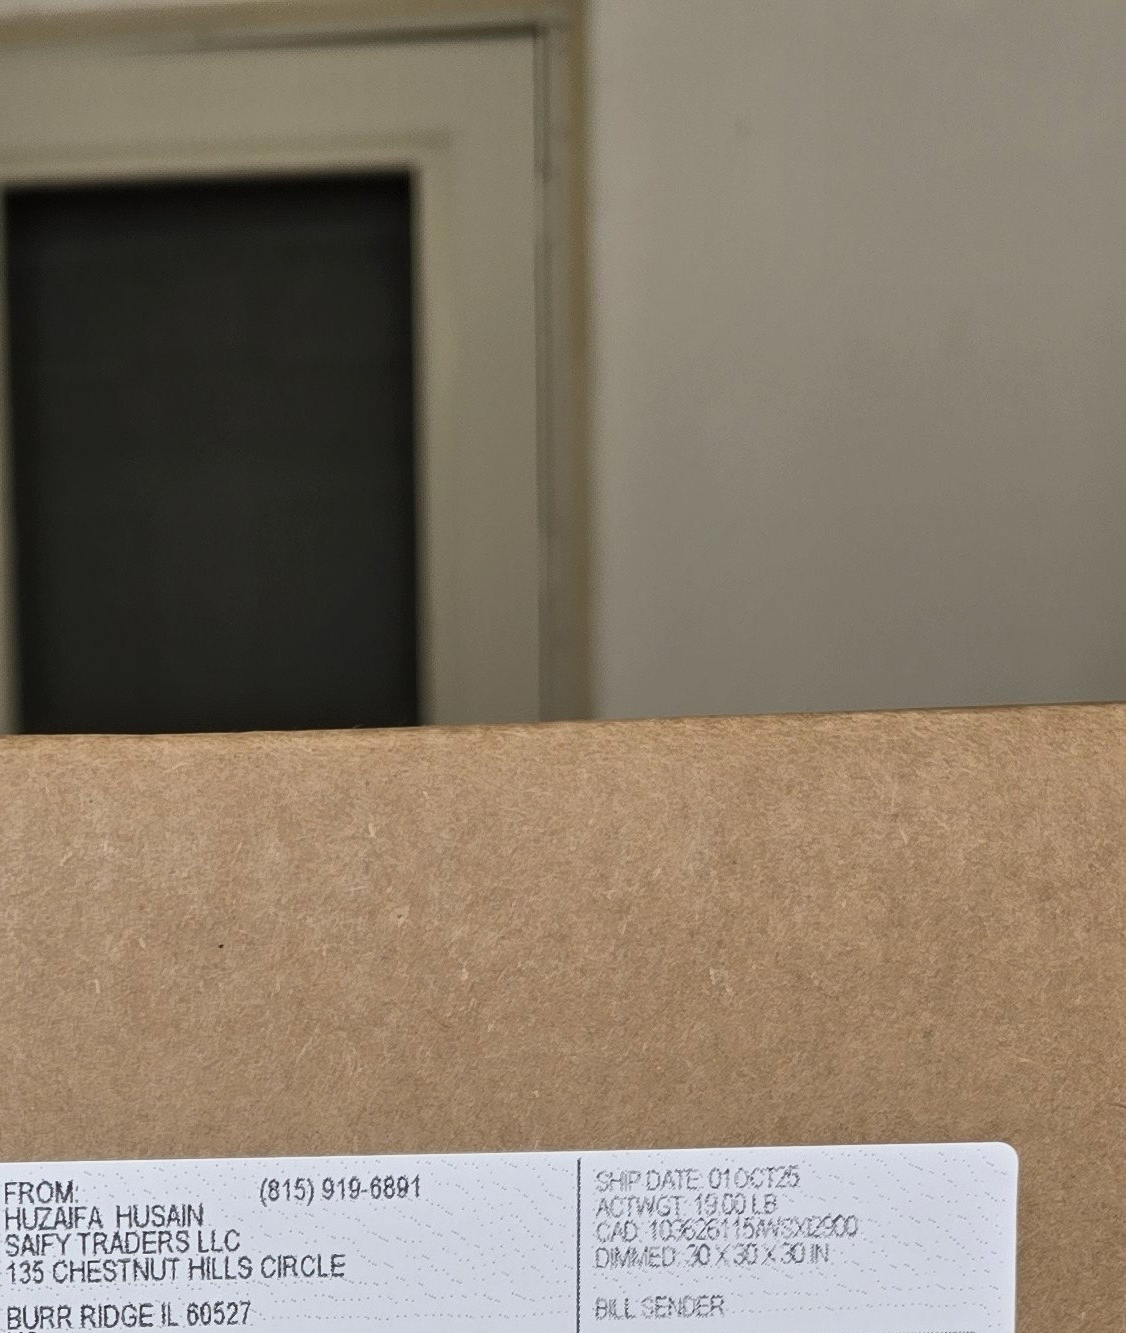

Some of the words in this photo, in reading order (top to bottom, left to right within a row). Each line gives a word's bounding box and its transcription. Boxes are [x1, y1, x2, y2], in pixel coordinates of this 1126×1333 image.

[3, 1180, 79, 1205] FROM:
[259, 1178, 315, 1205] (815)
[322, 1175, 421, 1200] 919-6891
[4, 1206, 104, 1231] HUZAIFA
[115, 1204, 205, 1228] HUSAIN
[5, 1232, 71, 1257] SAIFY
[77, 1231, 190, 1255] TRADERS
[197, 1229, 240, 1253] LLC
[9, 1260, 45, 1283] 135
[52, 1257, 179, 1283] CHESTNUT
[188, 1256, 252, 1281] HILLS
[261, 1254, 347, 1279] CIRCLE
[6, 1305, 72, 1330] BURR
[80, 1304, 153, 1328] RIDGE
[161, 1303, 178, 1327] IL
[187, 1301, 251, 1326] 60527
